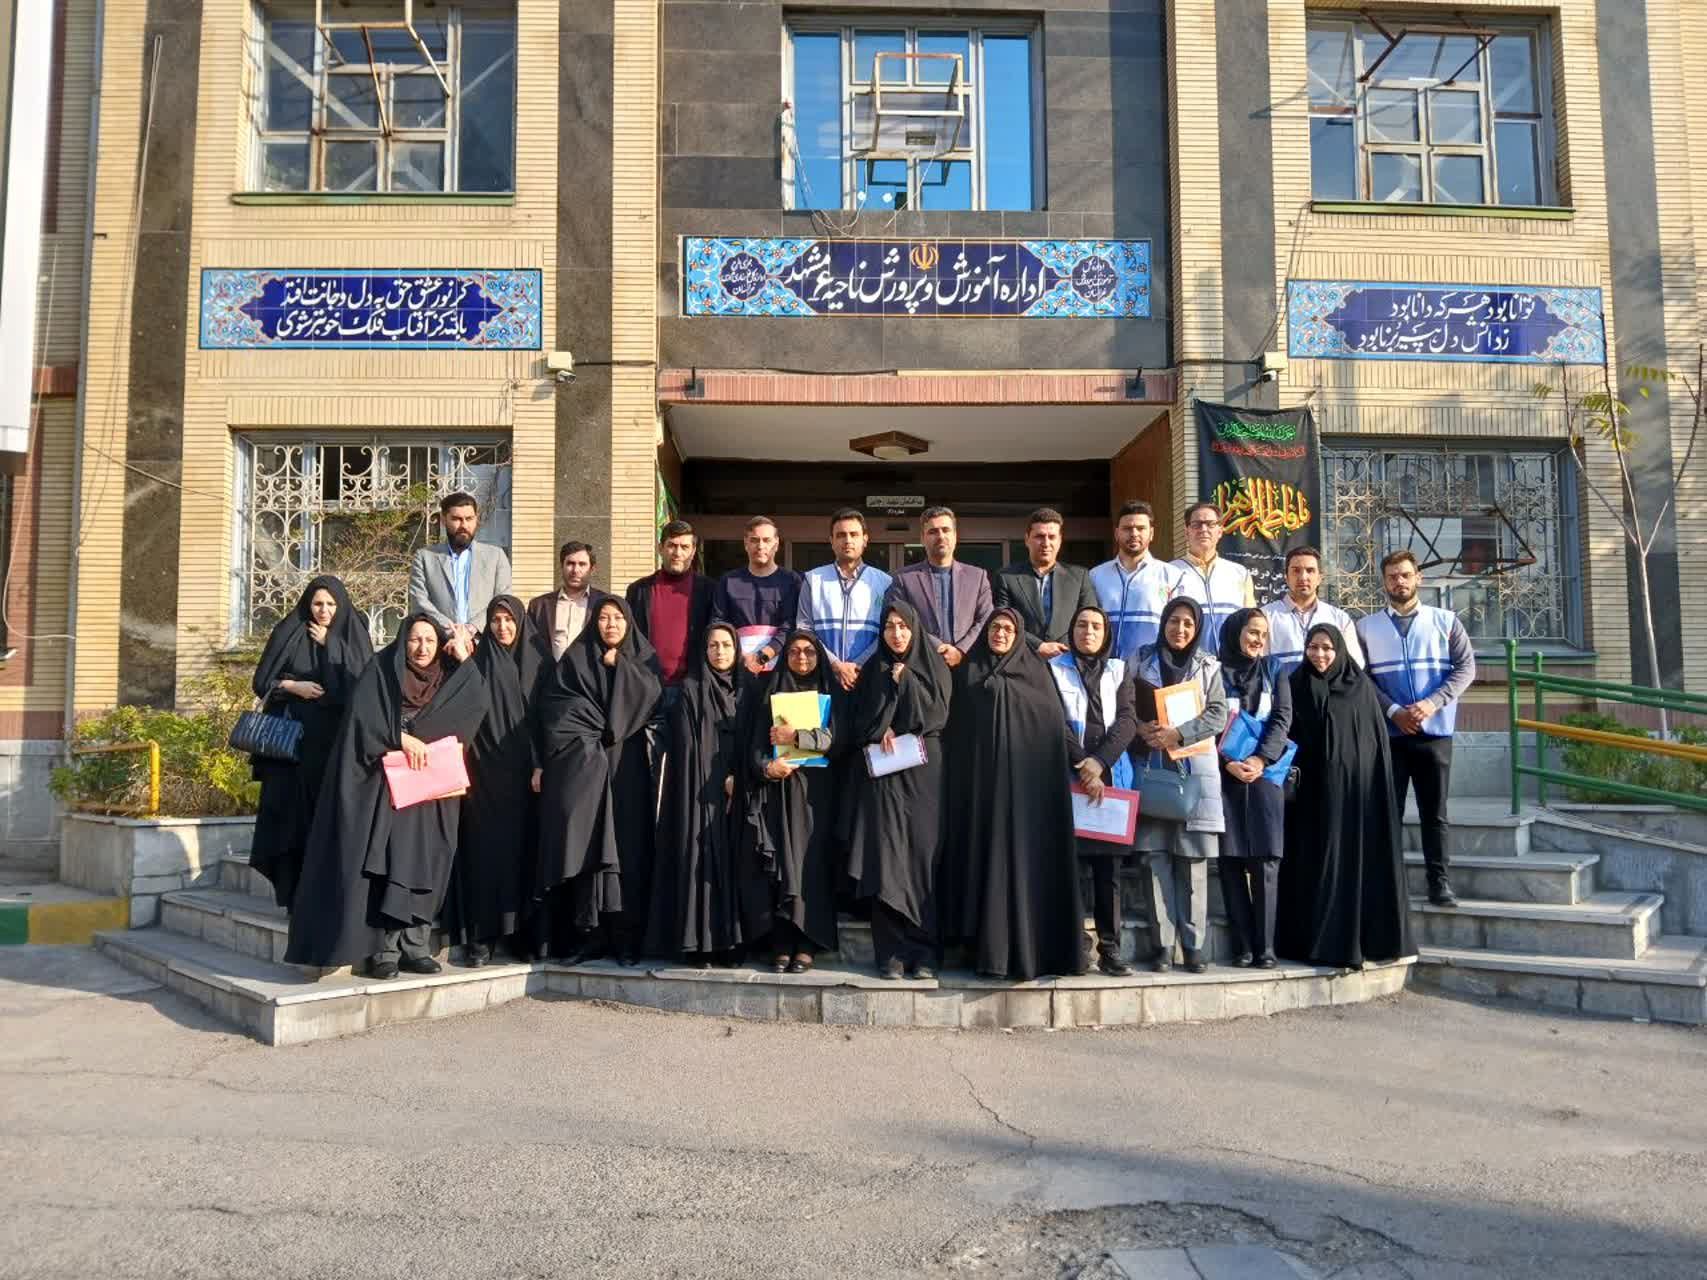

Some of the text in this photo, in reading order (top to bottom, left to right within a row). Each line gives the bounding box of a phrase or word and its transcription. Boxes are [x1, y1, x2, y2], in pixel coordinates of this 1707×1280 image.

[784, 246, 831, 284] مشهد
[860, 247, 928, 314] پرورش
[936, 251, 1006, 305] آموزش
[300, 279, 342, 311] جانت
[347, 278, 373, 310] دل
[385, 279, 413, 310] حق
[407, 277, 443, 310] عشق
[430, 280, 454, 309] نور
[820, 260, 867, 310] ناحیه
[920, 283, 934, 303] و
[1001, 265, 1046, 303] اداره
[373, 296, 385, 310] به
[1388, 291, 1536, 323] توانا بود هر که دانا بود
[276, 310, 313, 338] شوی
[338, 308, 386, 337] فلک
[382, 310, 437, 341] آفتاب
[1429, 321, 1459, 353] دل
[1461, 316, 1502, 353] دانش
[1357, 326, 1380, 352] بود
